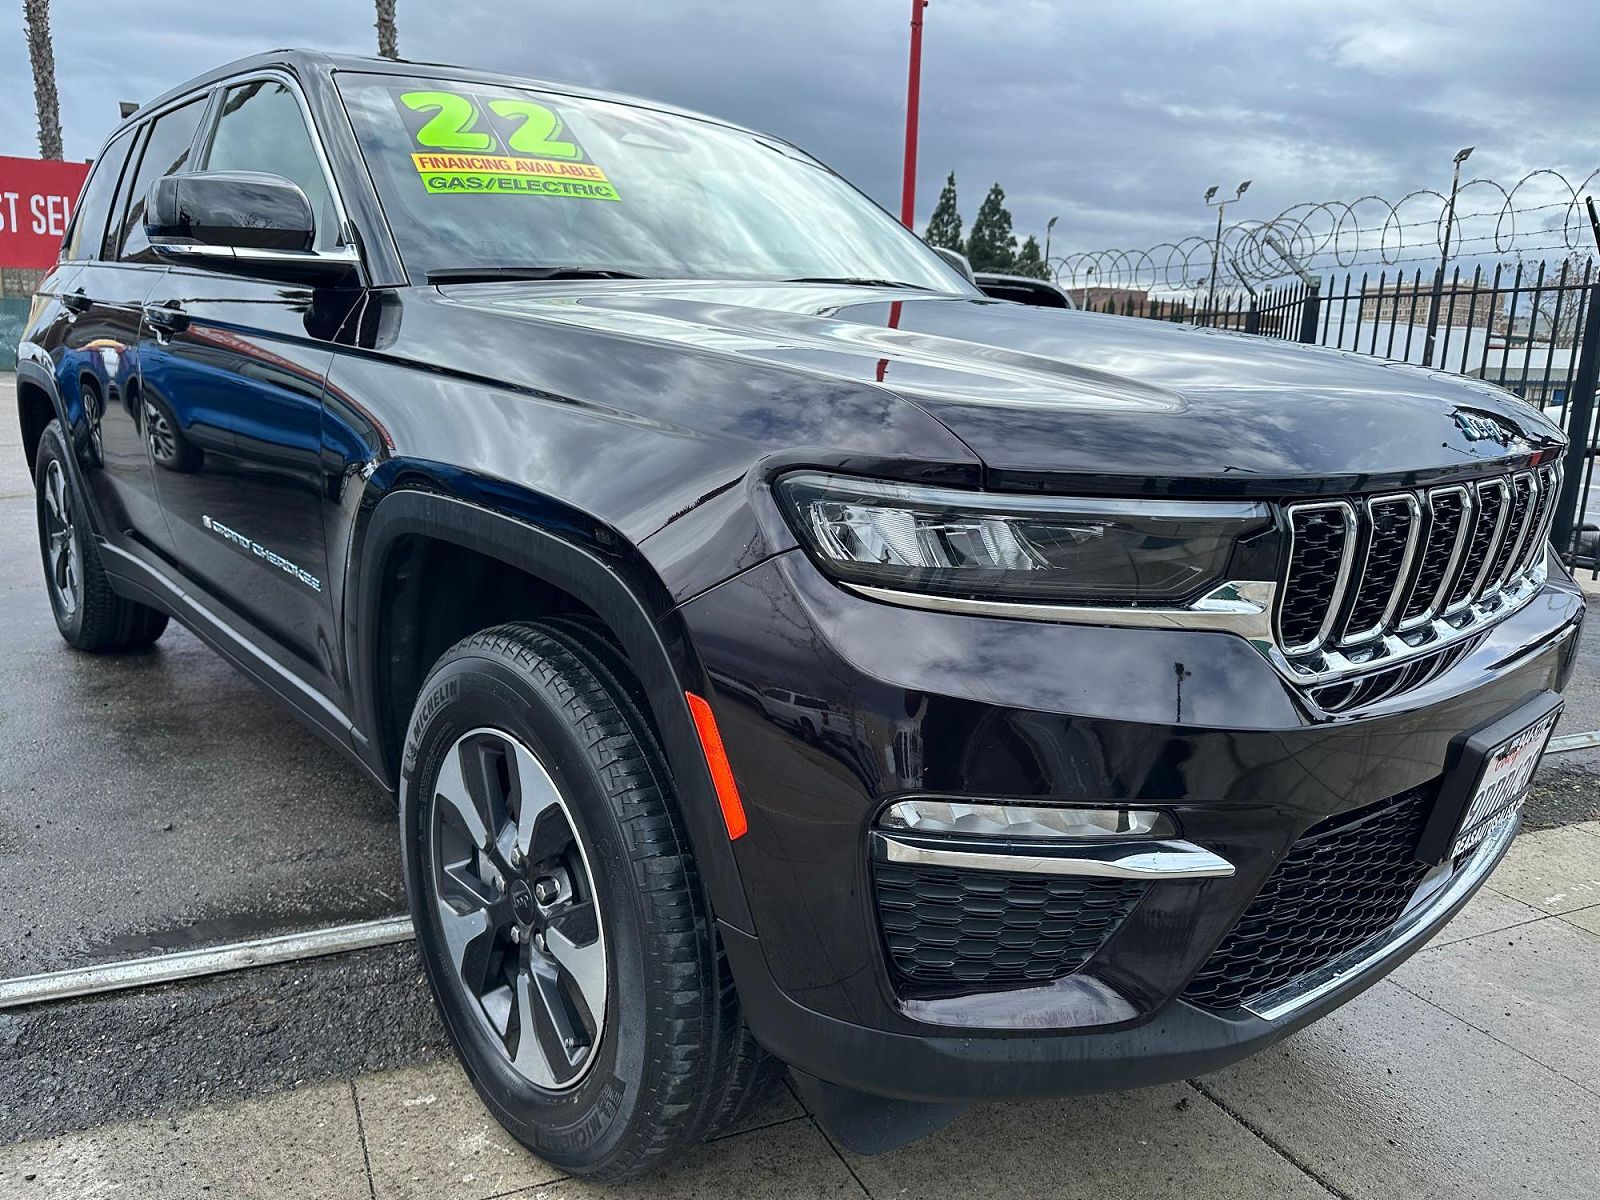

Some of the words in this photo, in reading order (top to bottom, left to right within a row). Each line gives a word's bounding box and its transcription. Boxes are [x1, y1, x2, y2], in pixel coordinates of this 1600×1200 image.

[400, 91, 581, 159] 22
[418, 156, 511, 171] FINANCING
[516, 160, 601, 178] AVAILABLE
[428, 176, 613, 197] GAS/ELECTRIC
[0, 191, 19, 233] T
[251, 542, 321, 592] CHEROKEE
[413, 681, 458, 742] MICHELIN
